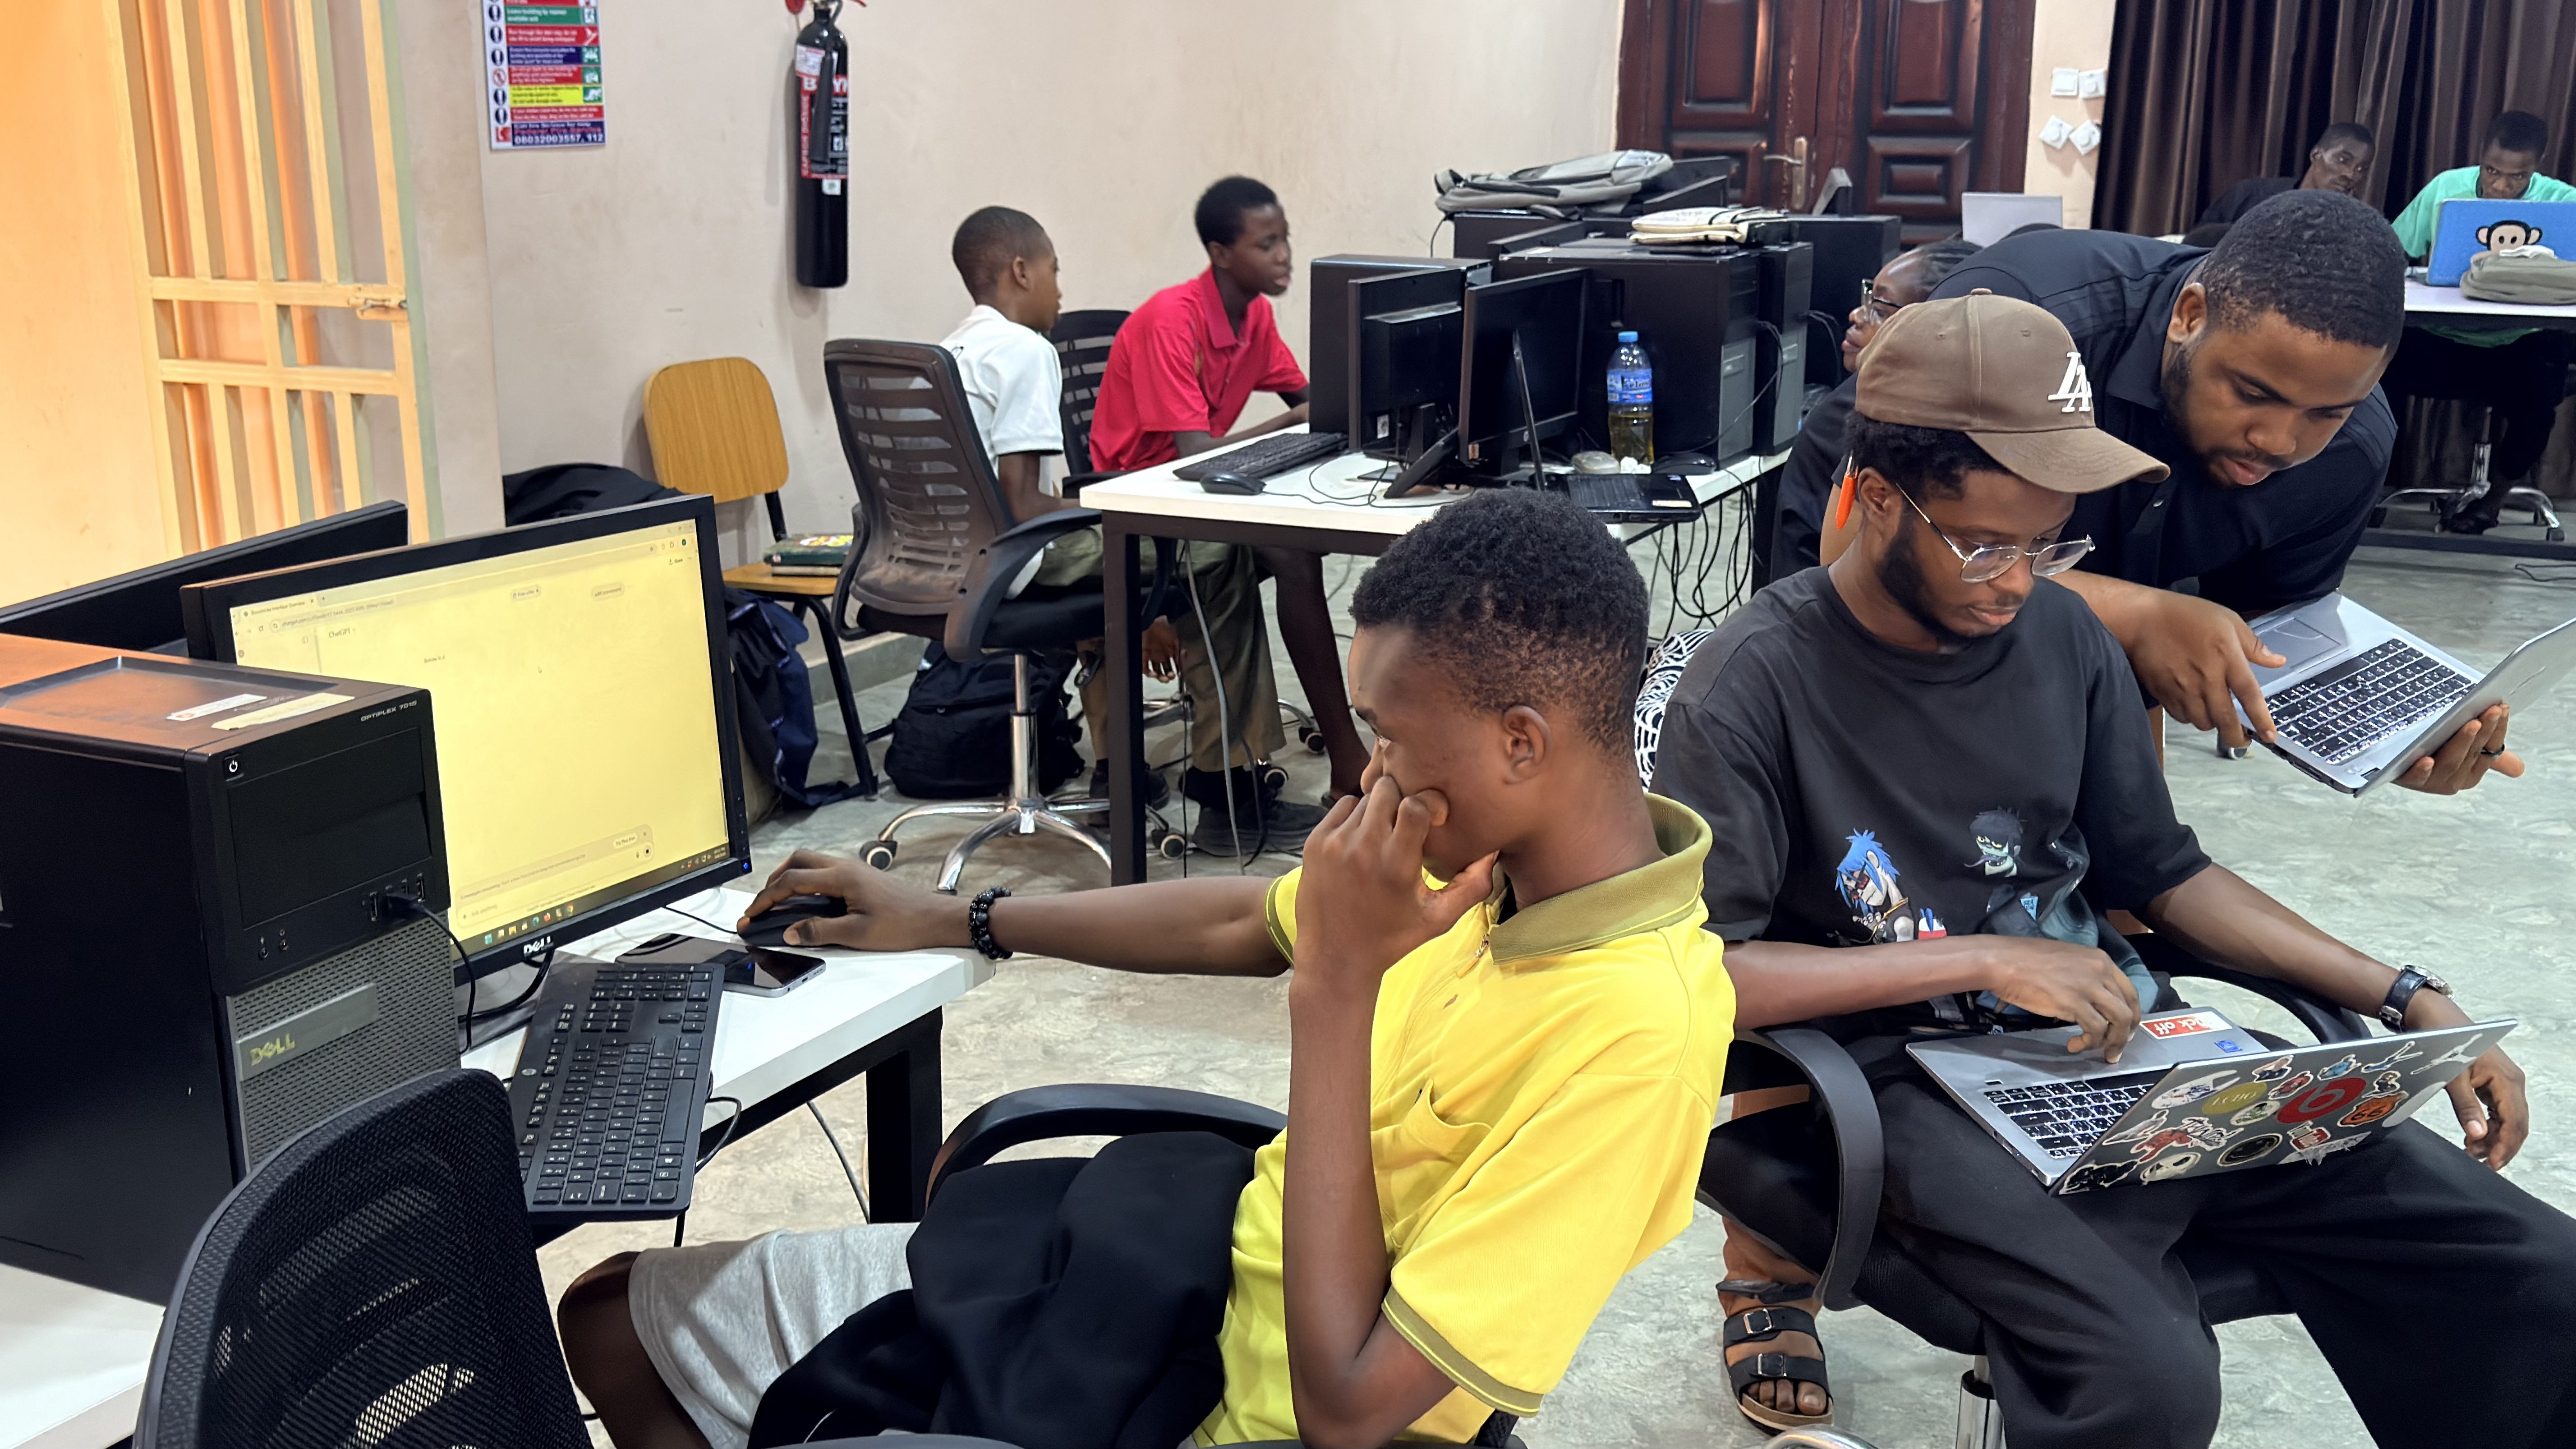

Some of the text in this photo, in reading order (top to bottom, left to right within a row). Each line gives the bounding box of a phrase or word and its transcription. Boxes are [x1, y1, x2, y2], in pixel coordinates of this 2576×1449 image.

[2048, 352, 2092, 413] LA
[328, 628, 351, 639] ChatGPT
[361, 707, 396, 722] OPTIPLEX
[2154, 1022, 2176, 1035] off
[250, 1033, 295, 1067] DELL
